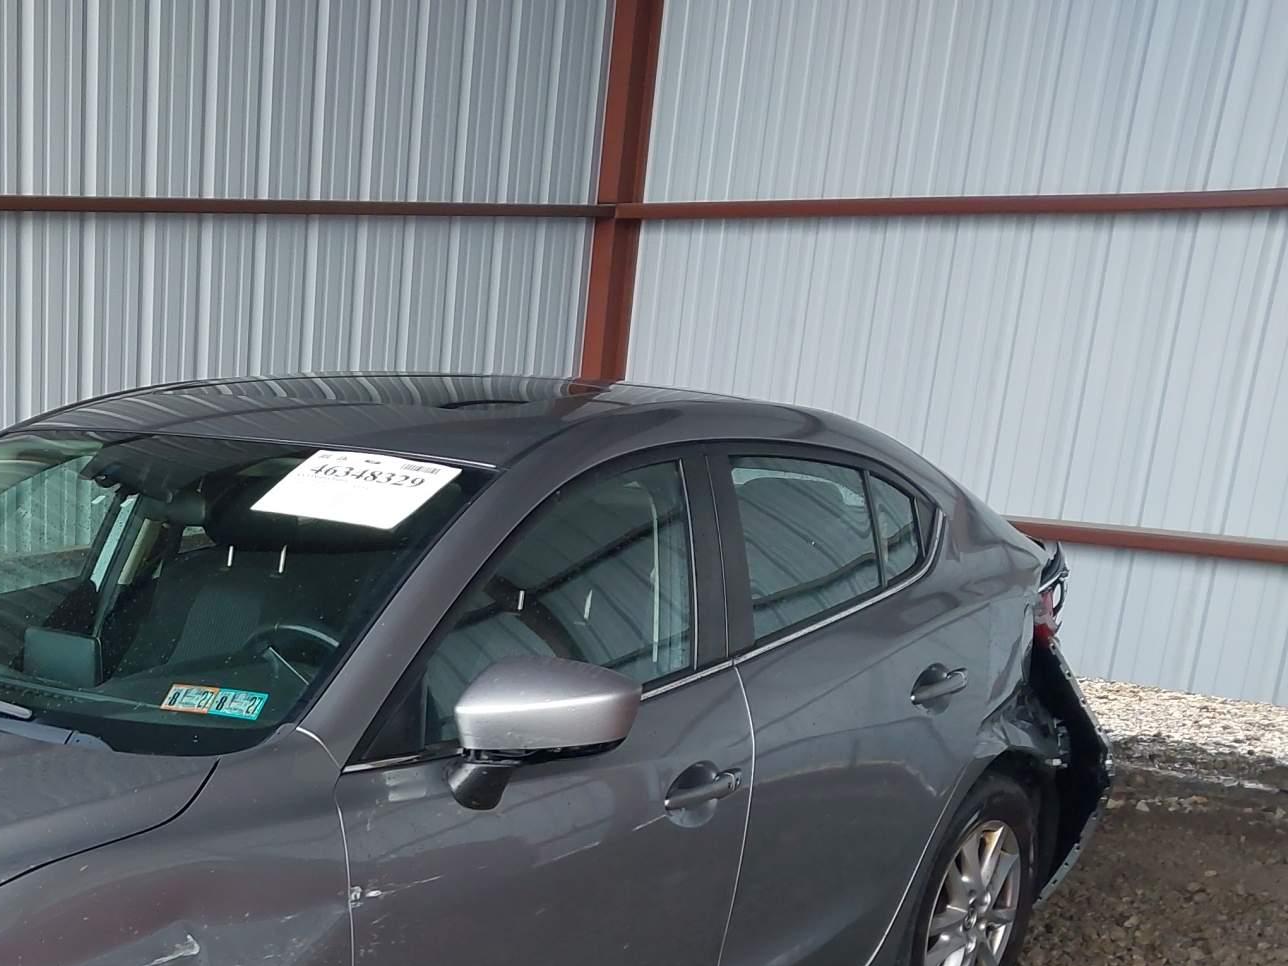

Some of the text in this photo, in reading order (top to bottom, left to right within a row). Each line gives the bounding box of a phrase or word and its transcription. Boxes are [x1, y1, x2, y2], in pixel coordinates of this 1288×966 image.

[310, 464, 425, 488] 46348329
[168, 691, 180, 706] 8
[197, 690, 214, 708] 27
[216, 695, 228, 711] 8
[245, 696, 264, 715] 27
